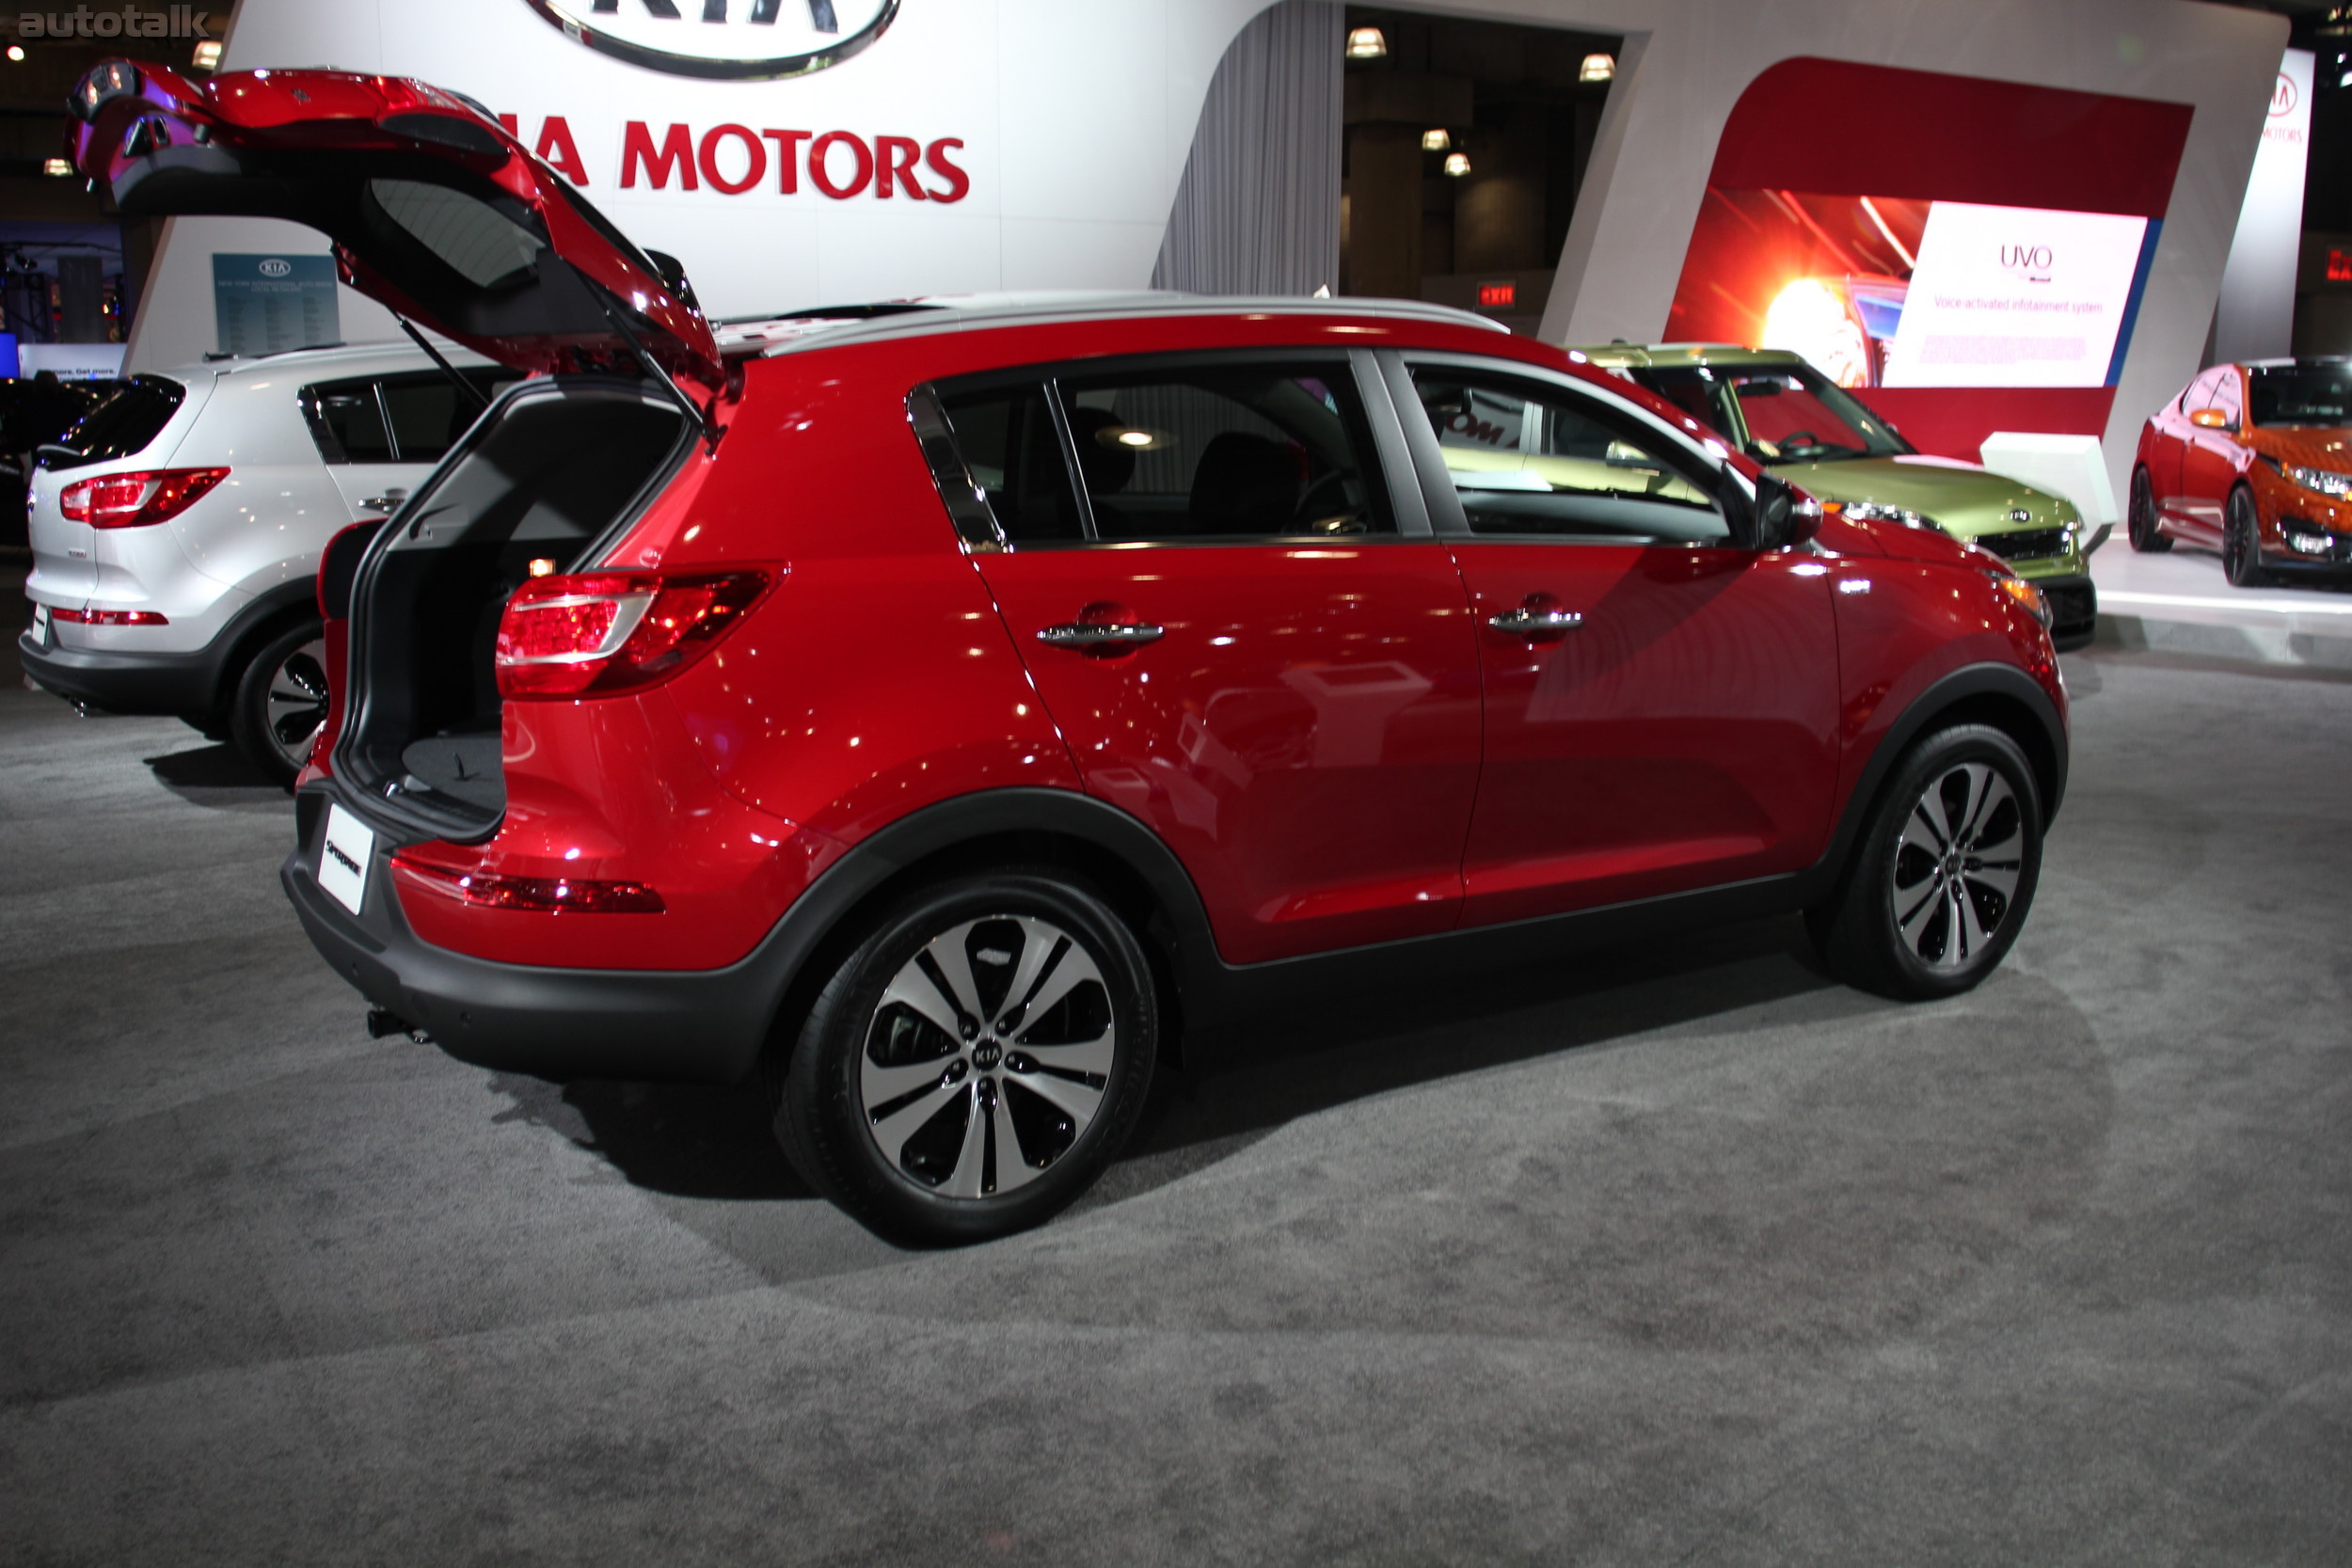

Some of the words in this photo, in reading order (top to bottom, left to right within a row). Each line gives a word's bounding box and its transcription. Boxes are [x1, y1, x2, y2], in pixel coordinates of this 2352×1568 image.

[2272, 84, 2289, 106] IA
[619, 120, 970, 203] MOTORS
[264, 262, 286, 274] KIA
[2000, 245, 2053, 270] UVO
[1934, 295, 2010, 310] Voice-activated
[2011, 298, 2070, 313] infotainment
[2072, 301, 2104, 316] system
[976, 1049, 1000, 1062] KIA
